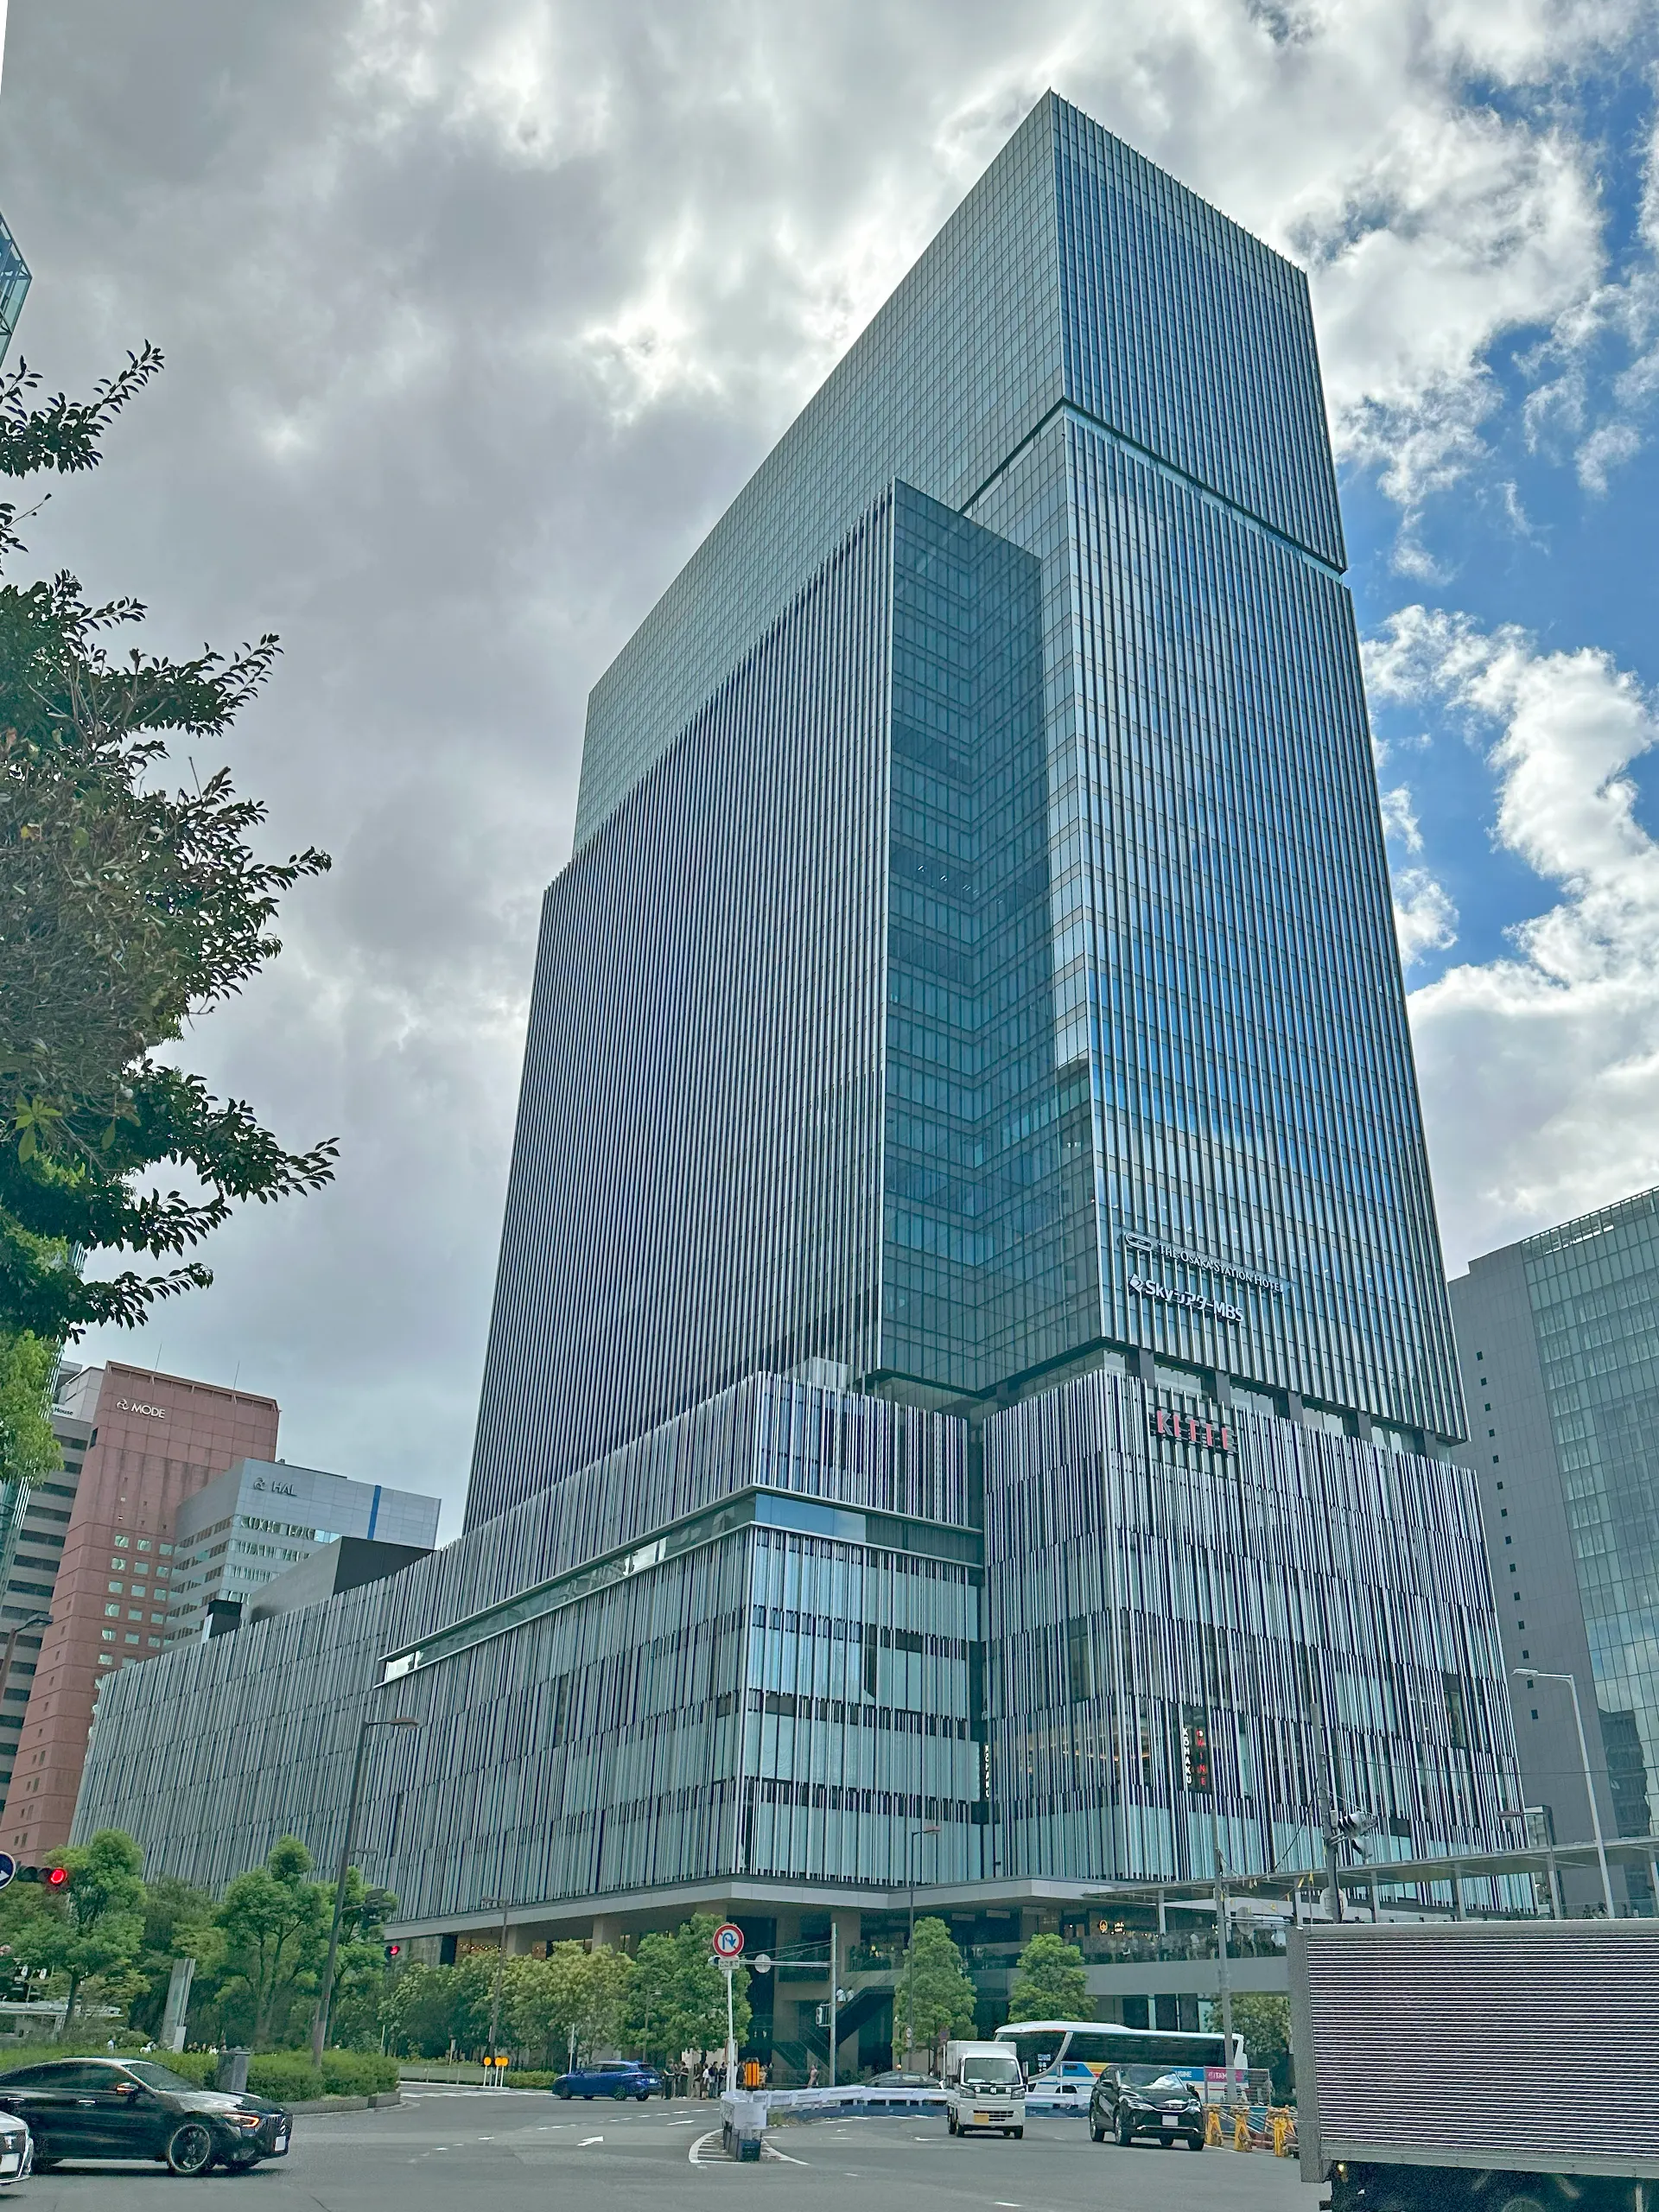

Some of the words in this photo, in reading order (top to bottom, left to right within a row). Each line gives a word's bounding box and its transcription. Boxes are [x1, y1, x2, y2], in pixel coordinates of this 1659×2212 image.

[1158, 1243, 1178, 1260] THE
[1180, 1250, 1213, 1270] OSAKA
[1213, 1261, 1253, 1283] STATION
[1254, 1274, 1284, 1293] HOTEL
[54, 1405, 73, 1416] House
[130, 1402, 166, 1419] MODE
[1156, 1409, 1236, 1452] KITTE
[271, 1480, 297, 1497] HAL
